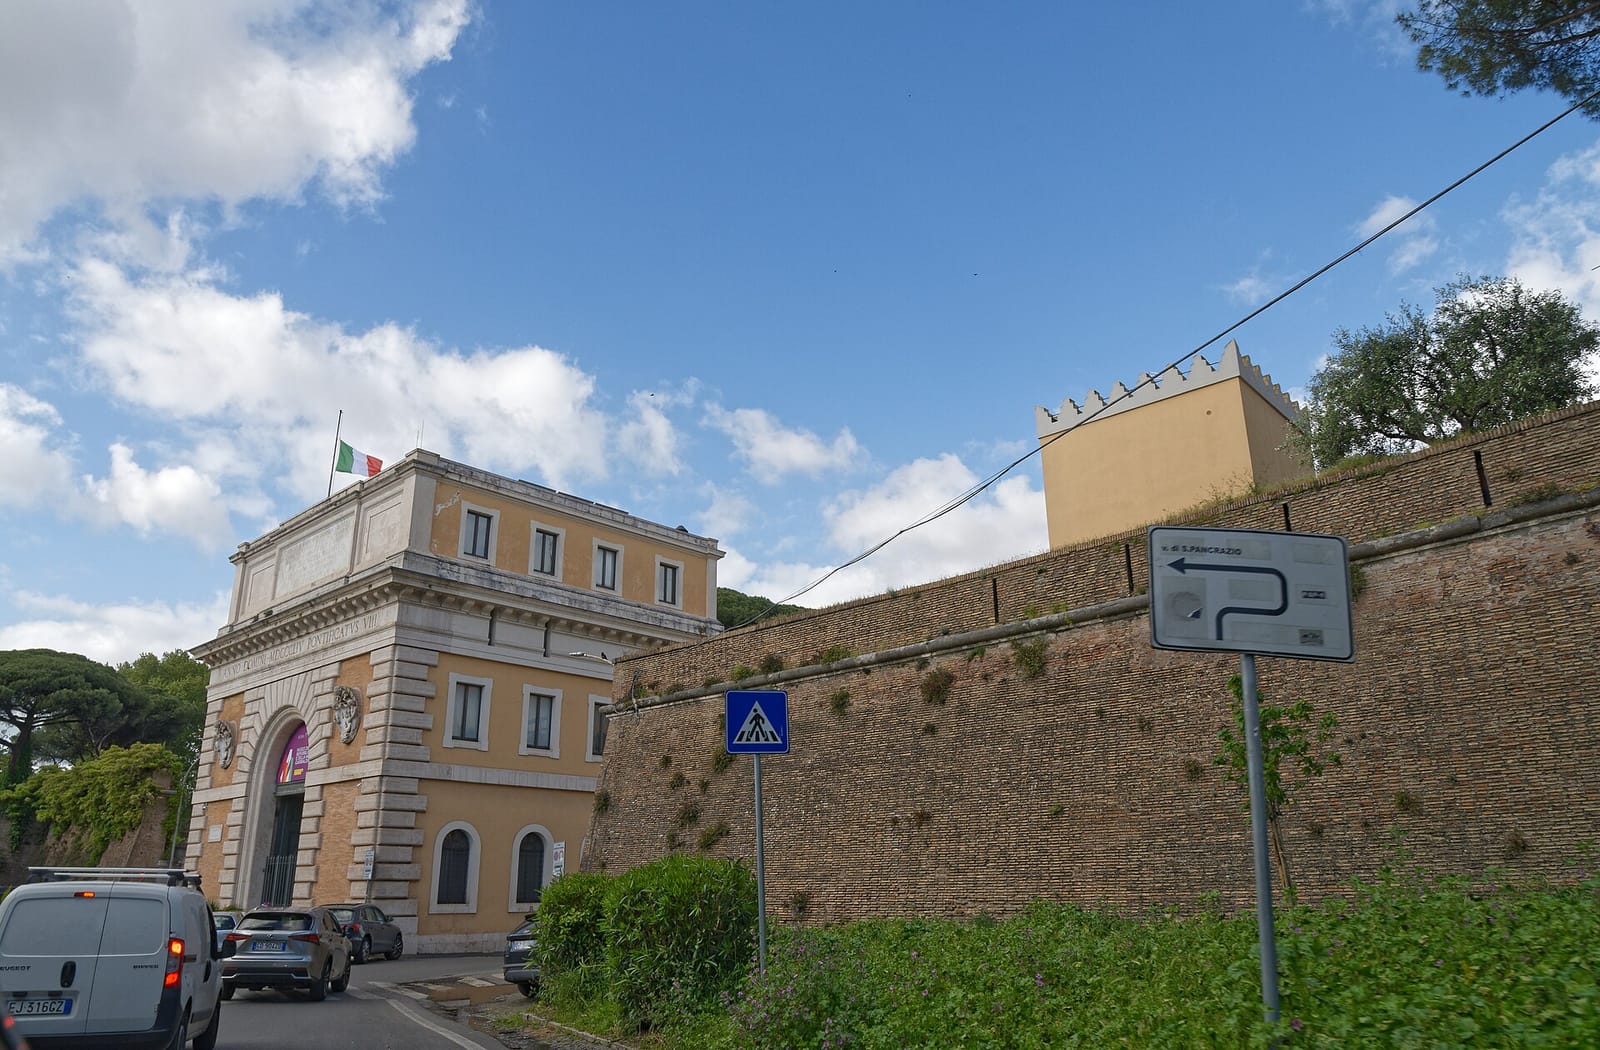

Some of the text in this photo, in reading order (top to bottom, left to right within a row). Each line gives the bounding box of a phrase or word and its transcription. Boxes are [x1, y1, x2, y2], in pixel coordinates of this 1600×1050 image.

[1182, 545, 1242, 556] S.PANCRAZIO
[243, 657, 266, 671] DOMINI
[8, 1001, 63, 1014] EJ 316GZ
